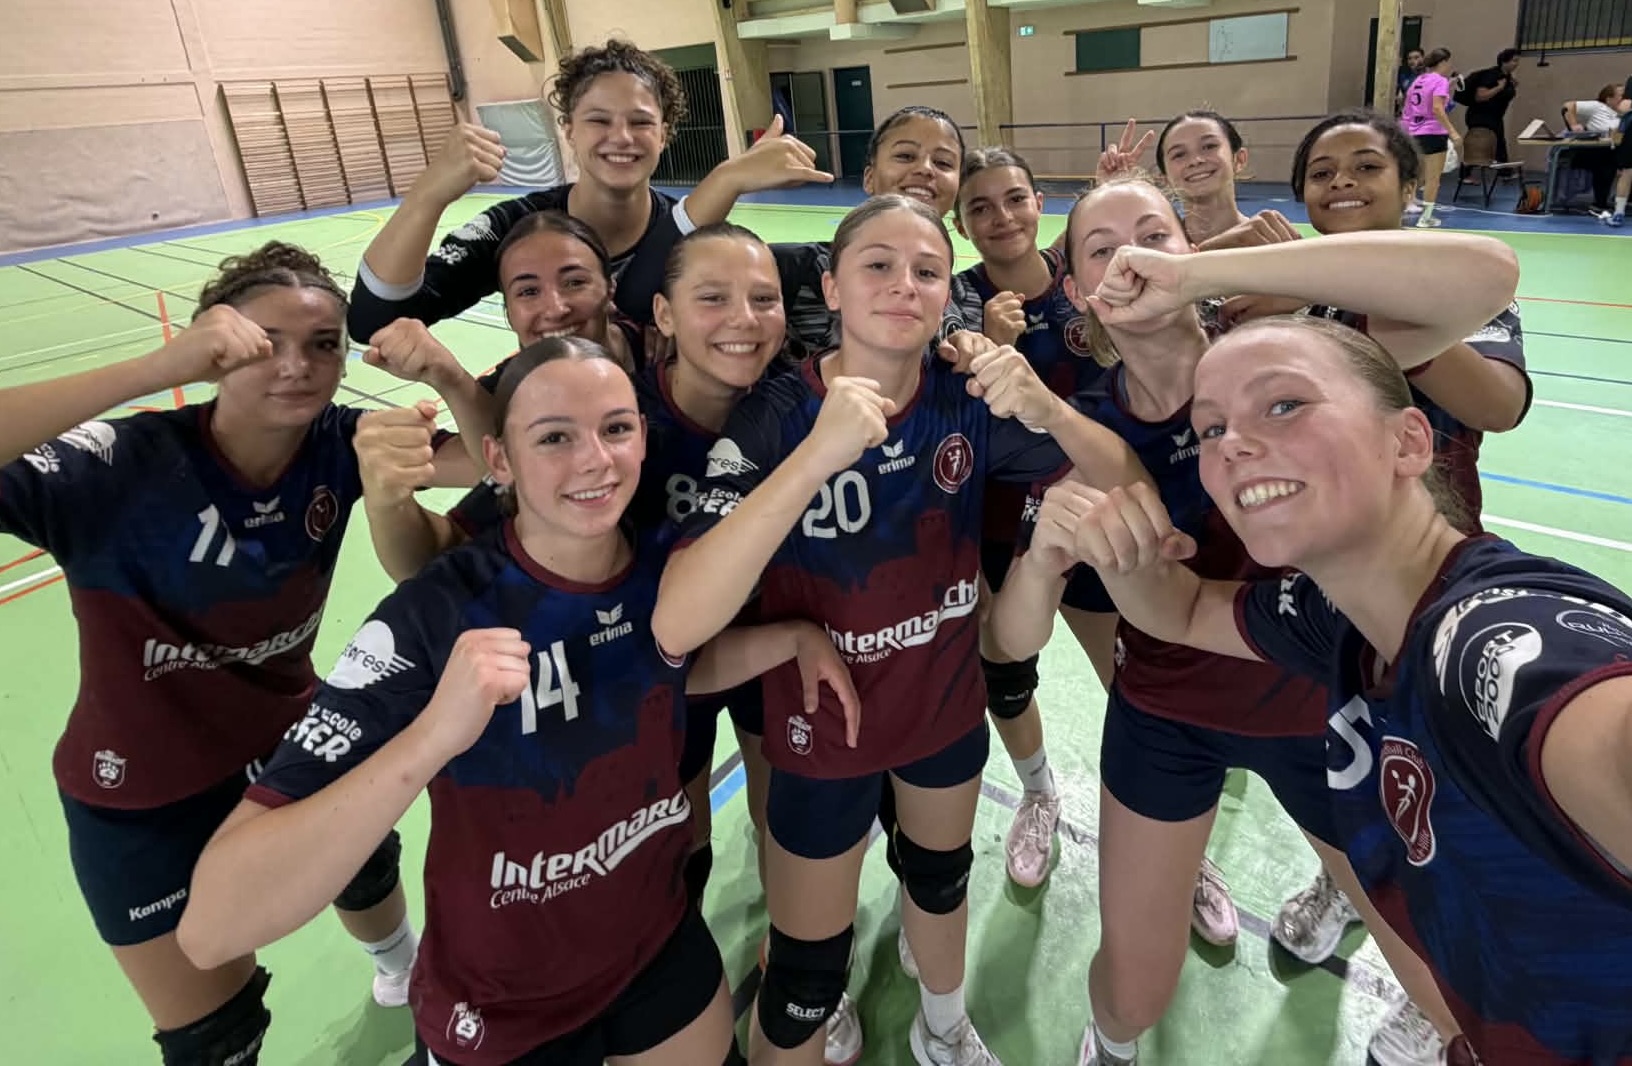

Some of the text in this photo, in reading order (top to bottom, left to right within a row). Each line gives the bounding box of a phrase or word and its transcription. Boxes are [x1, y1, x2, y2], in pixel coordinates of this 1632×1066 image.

[877, 455, 916, 475] erima
[665, 473, 698, 523] 8
[802, 470, 872, 539] 20
[244, 510, 286, 529] erima
[589, 620, 634, 647] erima
[520, 639, 581, 736] 14
[128, 887, 187, 922] Kempa
[540, 872, 591, 905] Alsace
[786, 1002, 826, 1019] SELECT
